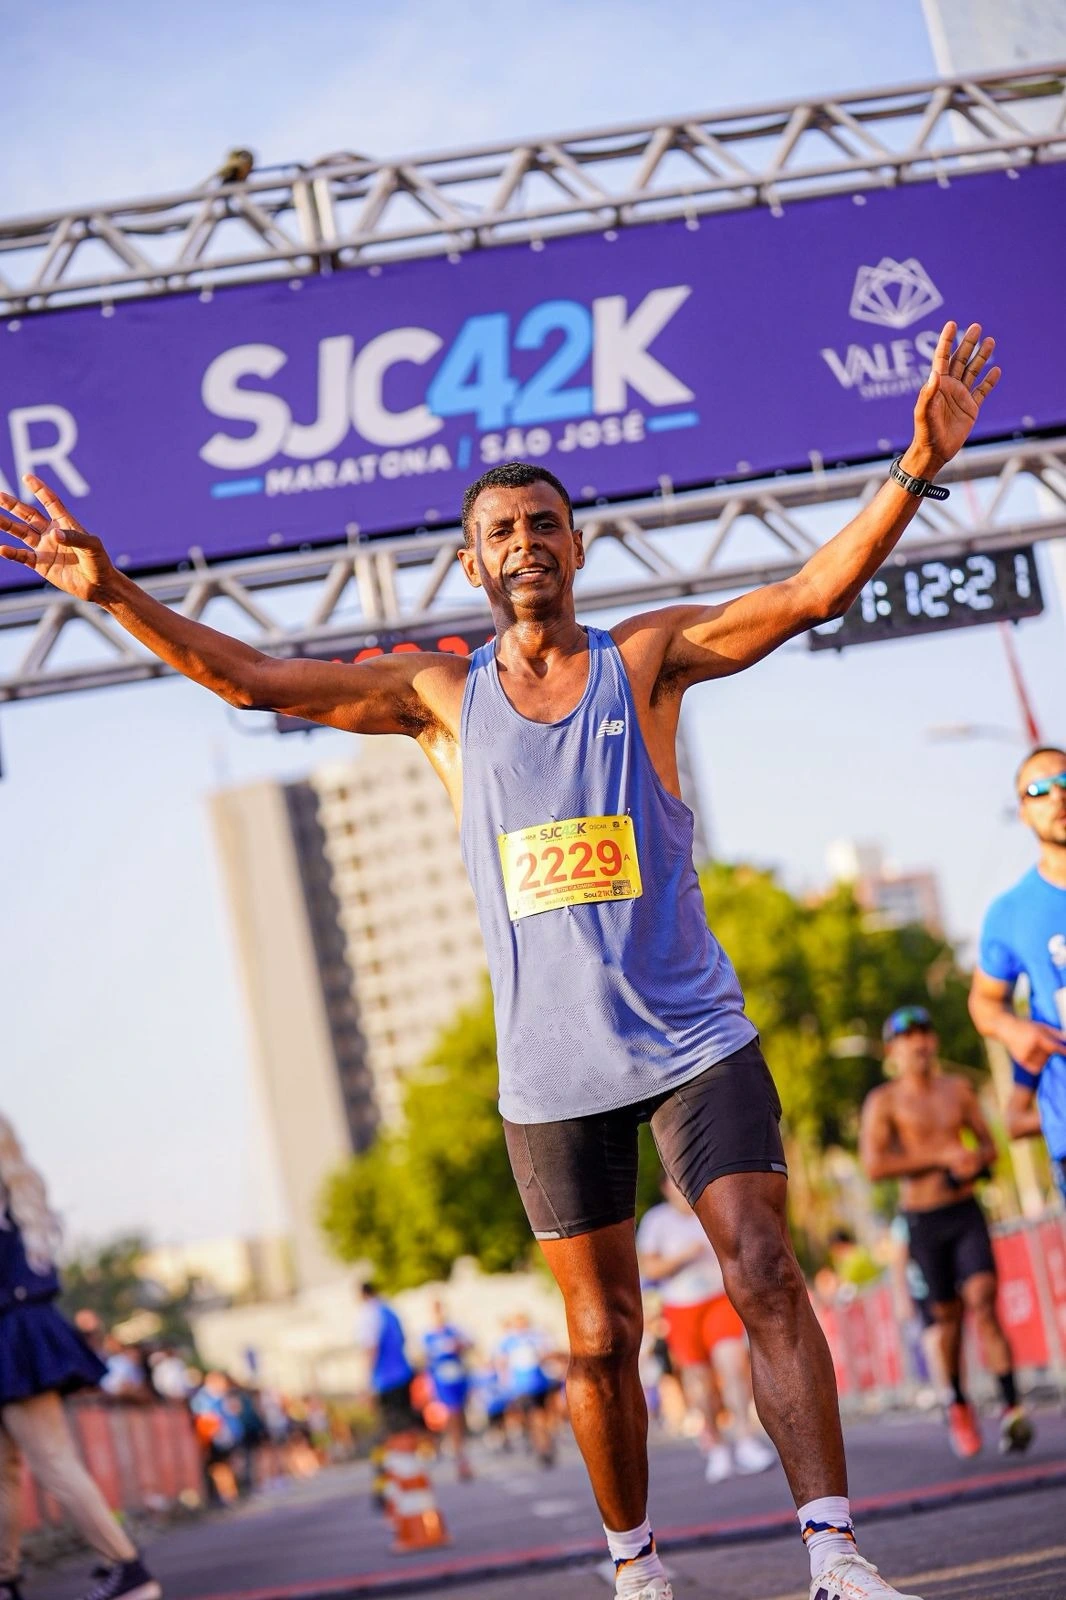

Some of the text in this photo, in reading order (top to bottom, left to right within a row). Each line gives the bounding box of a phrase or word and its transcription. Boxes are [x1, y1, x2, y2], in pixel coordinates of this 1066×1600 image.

[200, 285, 695, 470] SJC42K
[0, 403, 91, 504] R
[265, 412, 646, 497] MARATONA SÃO JOSÉ
[516, 839, 623, 892] 2229
[623, 853, 631, 862] A
[540, 822, 587, 841] SJC42K
[583, 891, 598, 899] Sou
